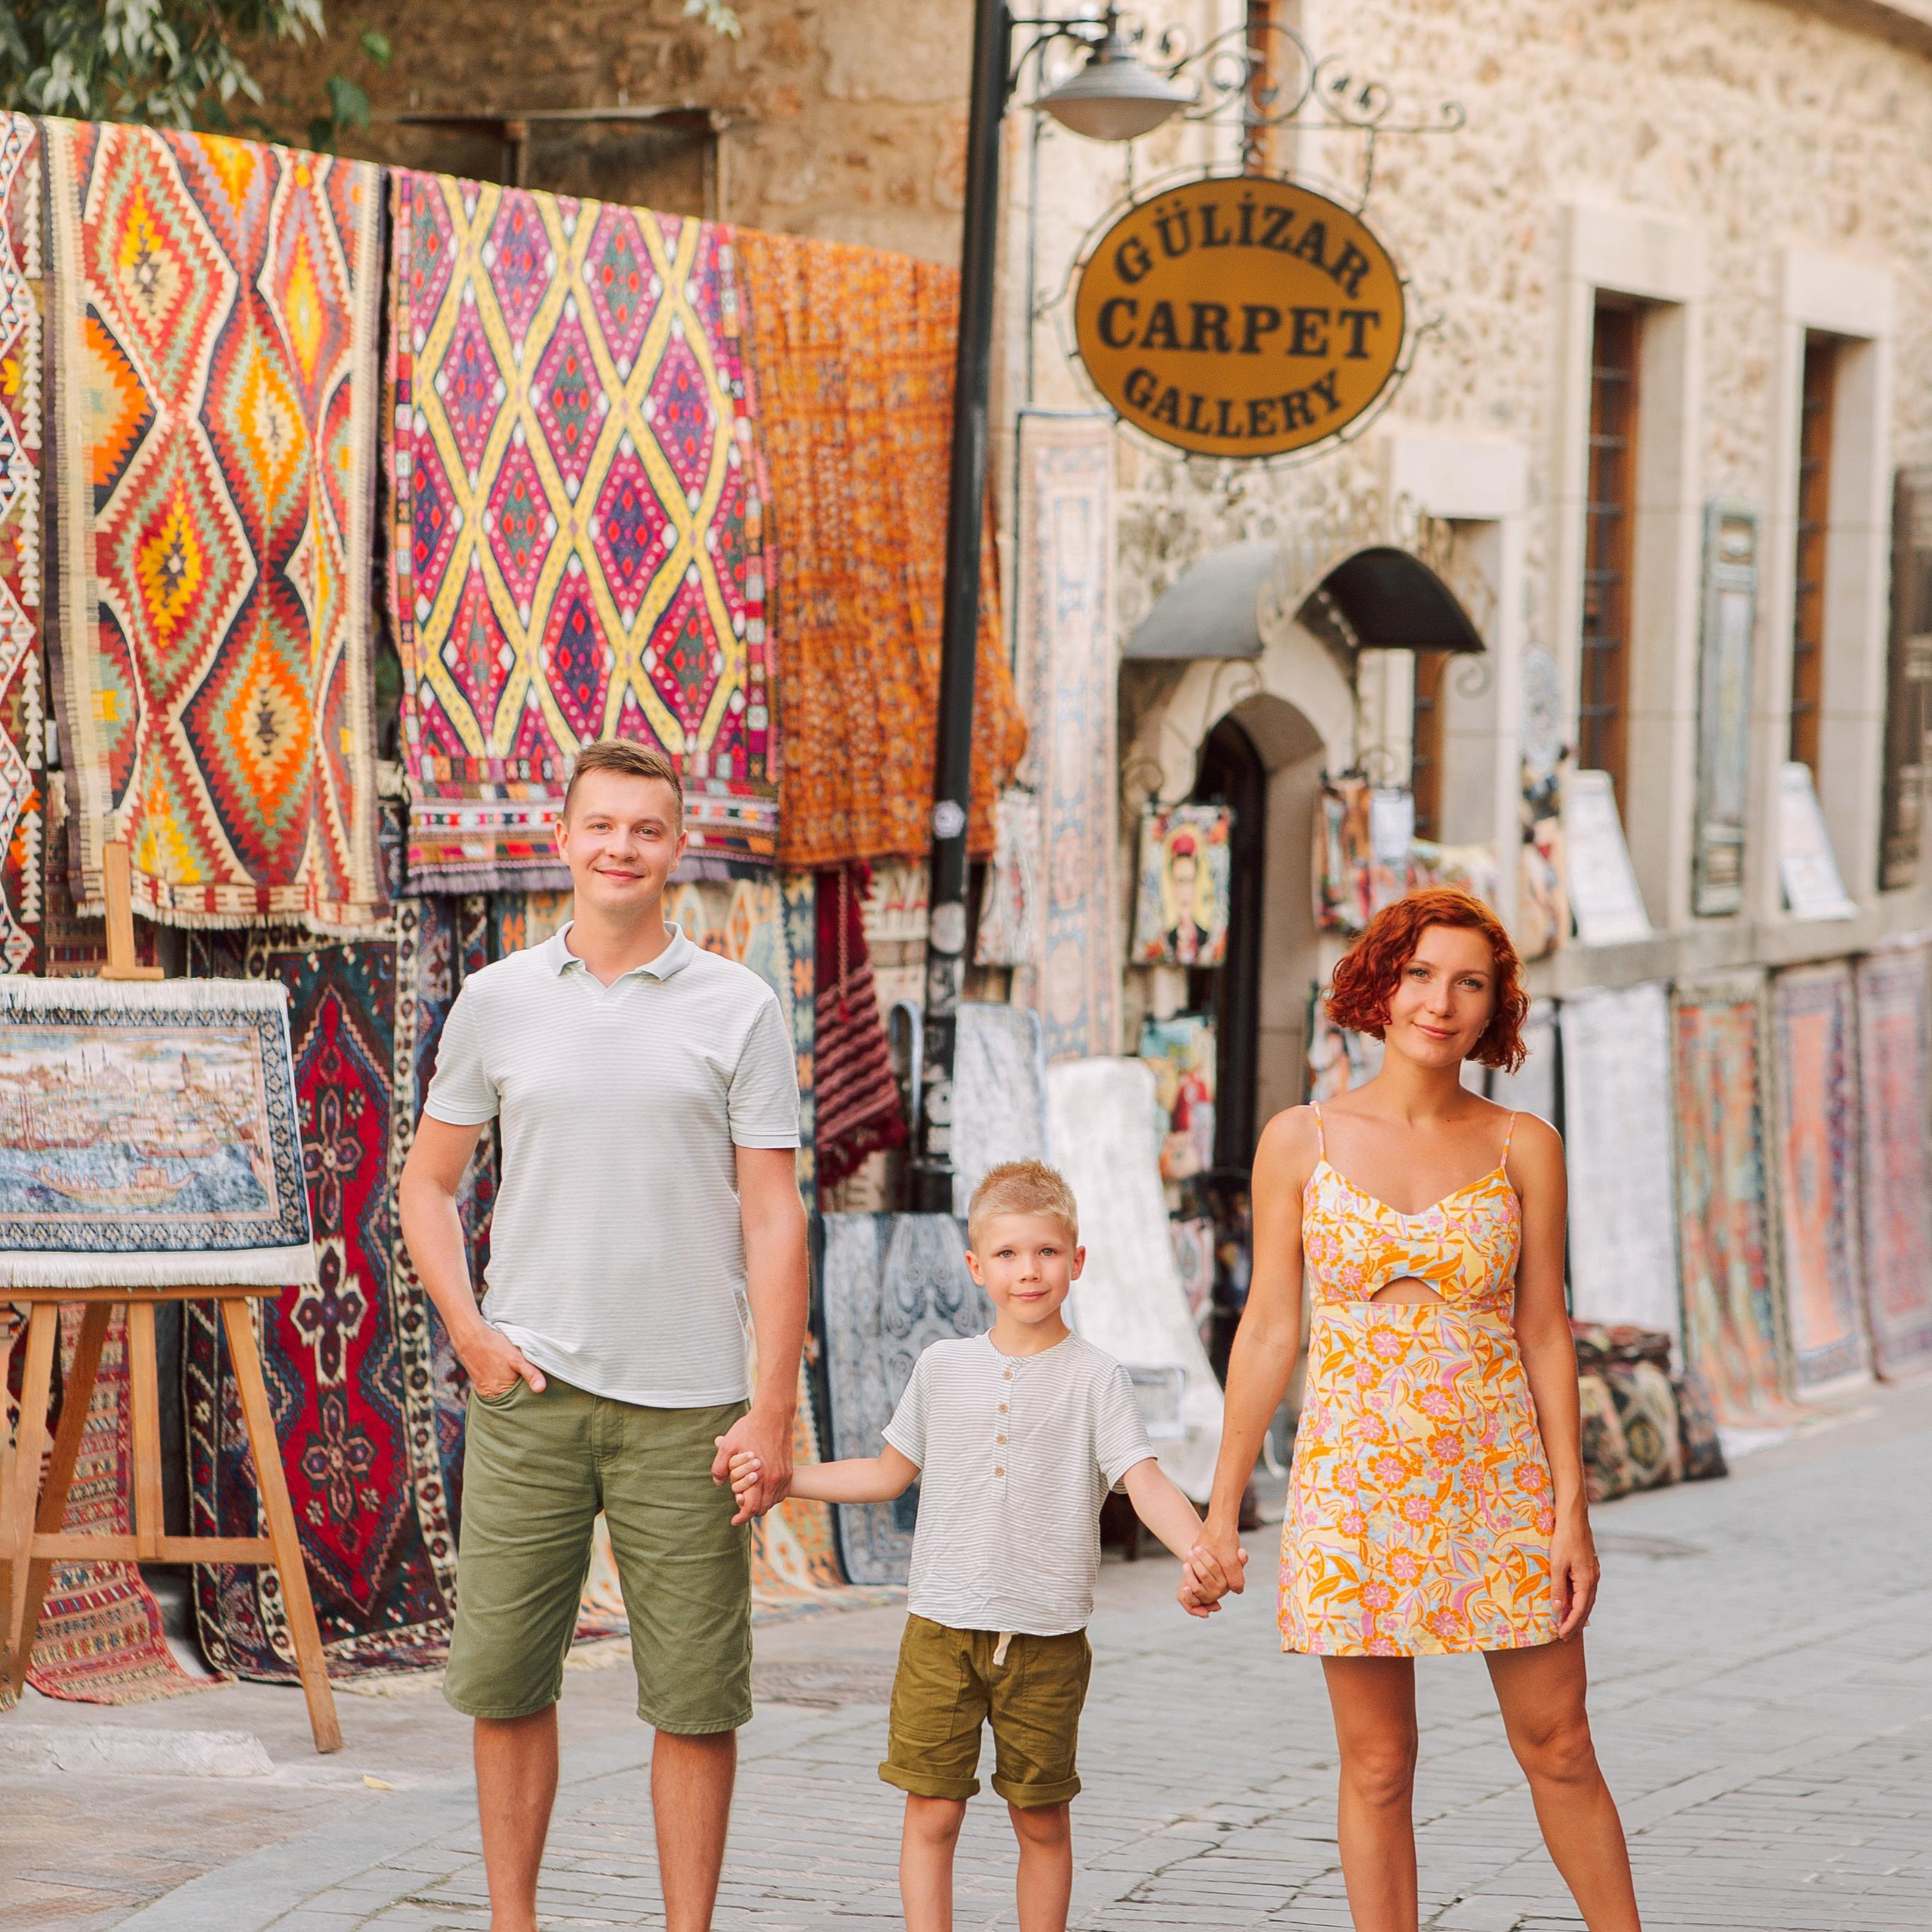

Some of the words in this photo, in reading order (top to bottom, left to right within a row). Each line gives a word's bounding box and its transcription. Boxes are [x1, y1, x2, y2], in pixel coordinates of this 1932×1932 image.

[1114, 192, 1370, 299] GÜLİZAR
[1097, 297, 1381, 360] CARPET
[1123, 368, 1343, 438] GALLERY
